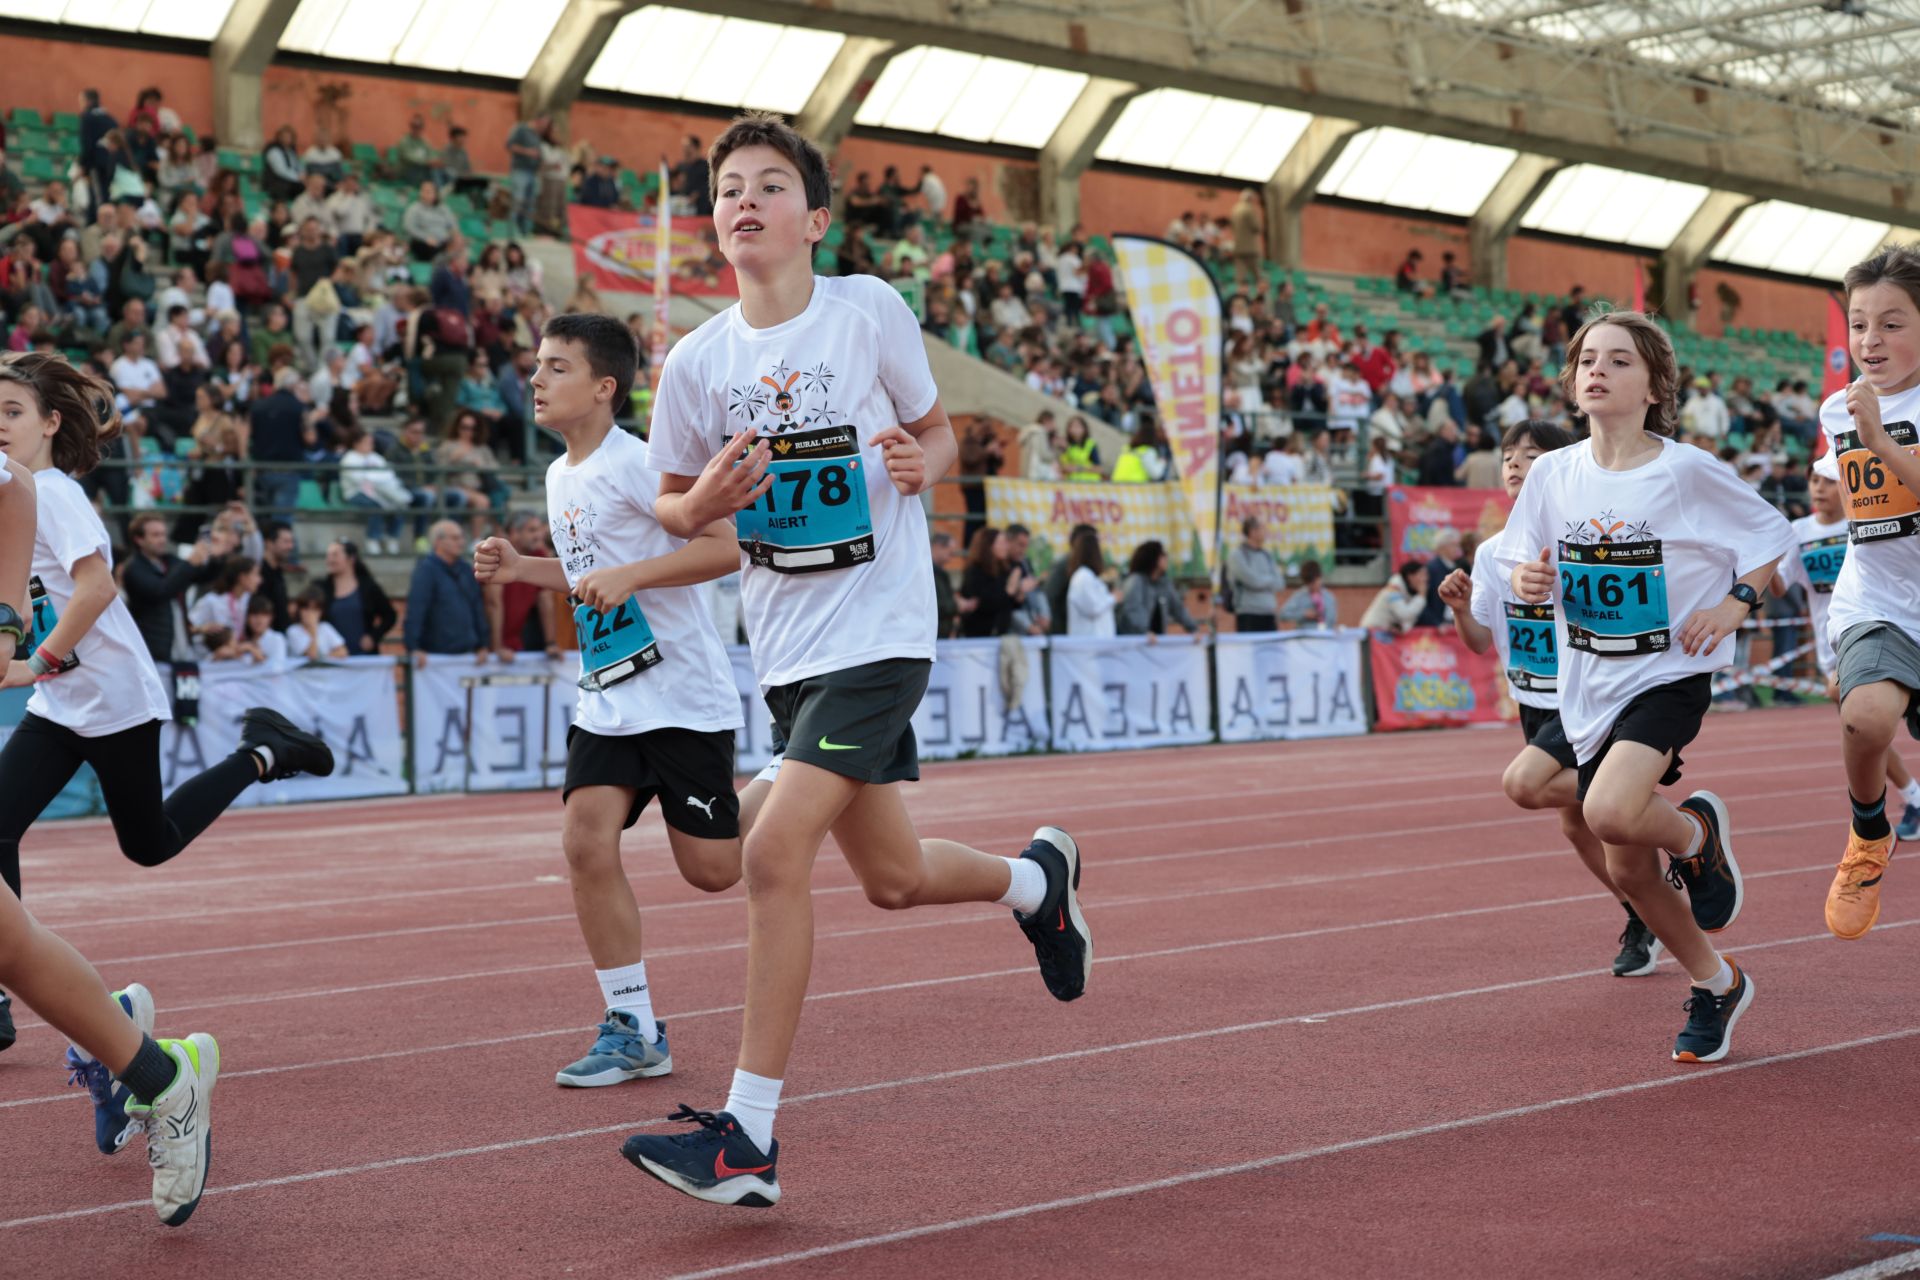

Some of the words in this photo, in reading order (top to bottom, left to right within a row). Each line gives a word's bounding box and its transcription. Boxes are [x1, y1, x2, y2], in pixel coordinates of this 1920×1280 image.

[795, 440, 821, 450] RURAL
[821, 434, 850, 446] KUTXA
[743, 465, 851, 513] 178
[768, 515, 808, 529] AIERT
[1562, 569, 1649, 608] 2161
[1581, 608, 1624, 621] RAFAEL
